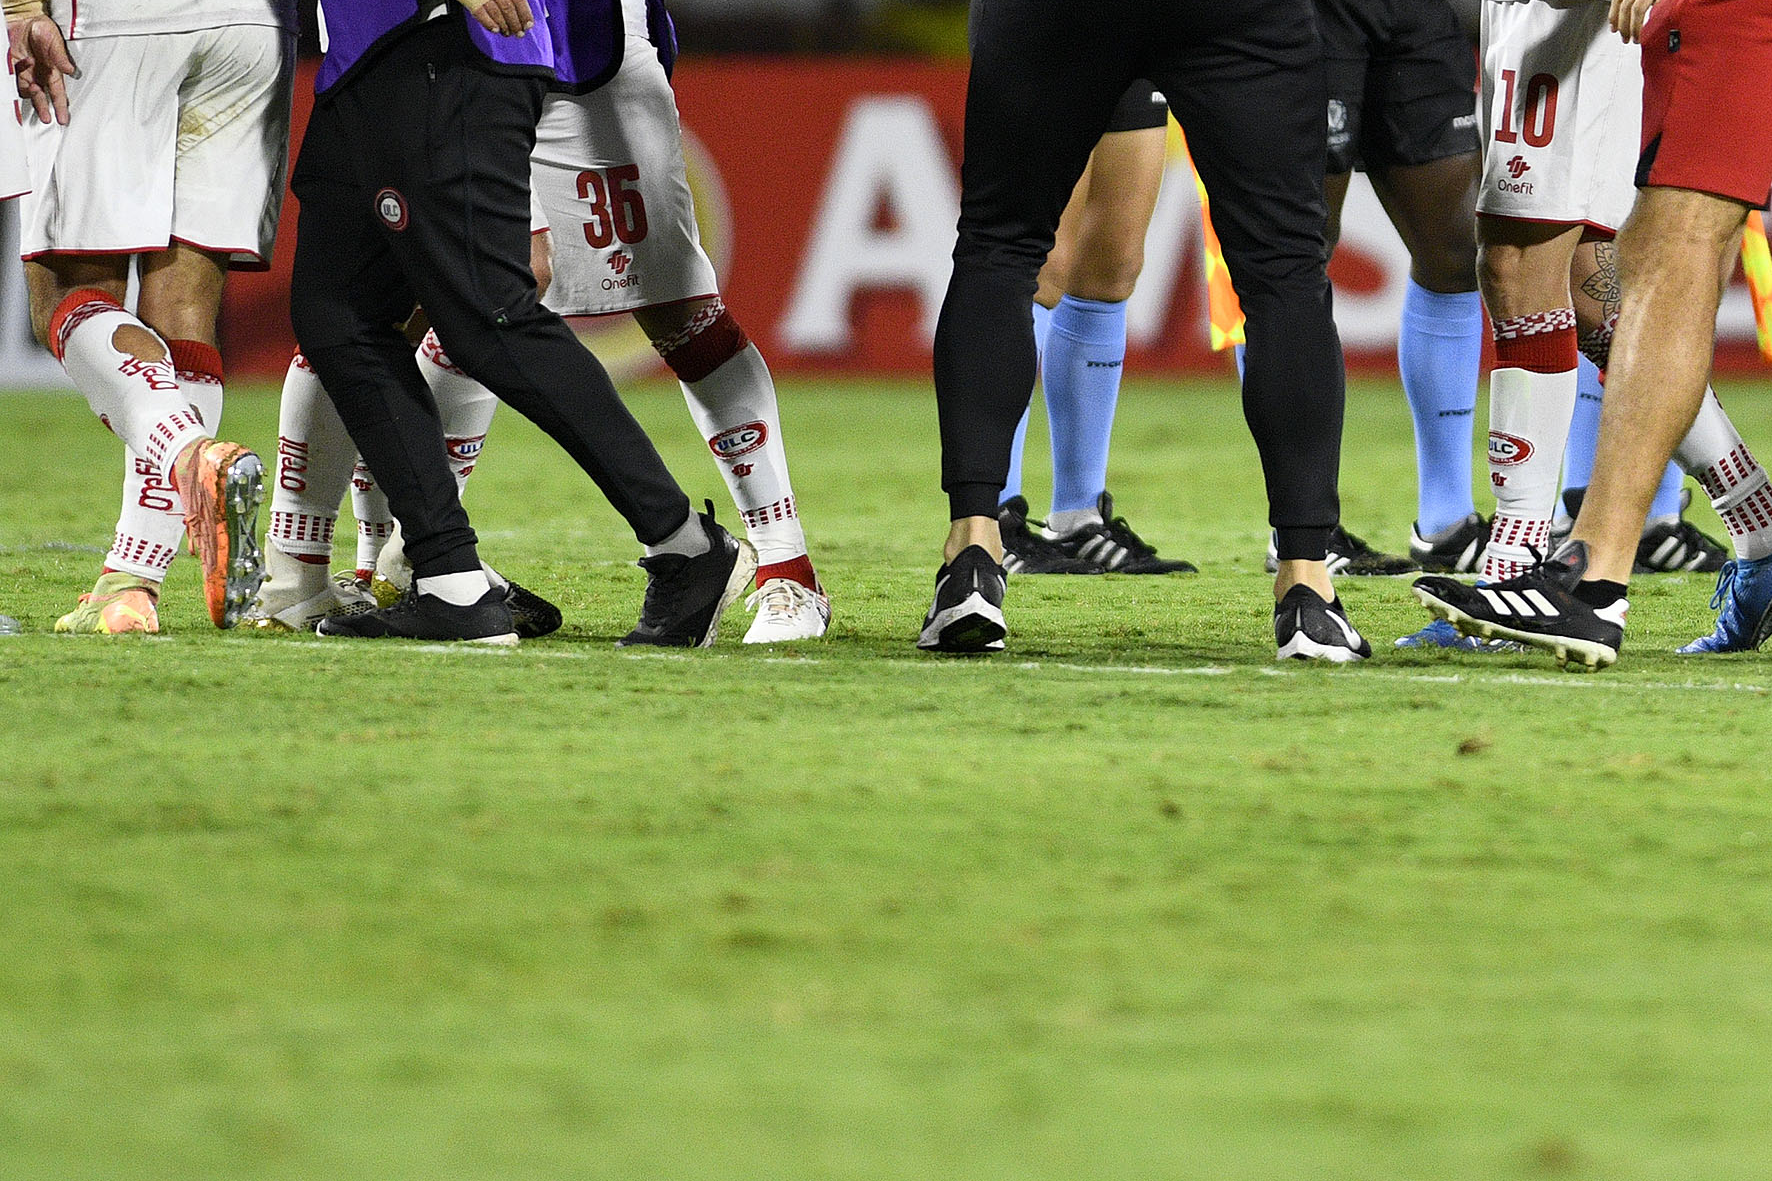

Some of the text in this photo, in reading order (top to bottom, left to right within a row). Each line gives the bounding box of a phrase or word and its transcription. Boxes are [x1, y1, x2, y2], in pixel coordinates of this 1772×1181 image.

[1495, 69, 1559, 148] 10
[1498, 179, 1534, 195] Onefit
[576, 163, 648, 249] 36
[601, 274, 640, 291] Onefit
[717, 431, 756, 451] ULC
